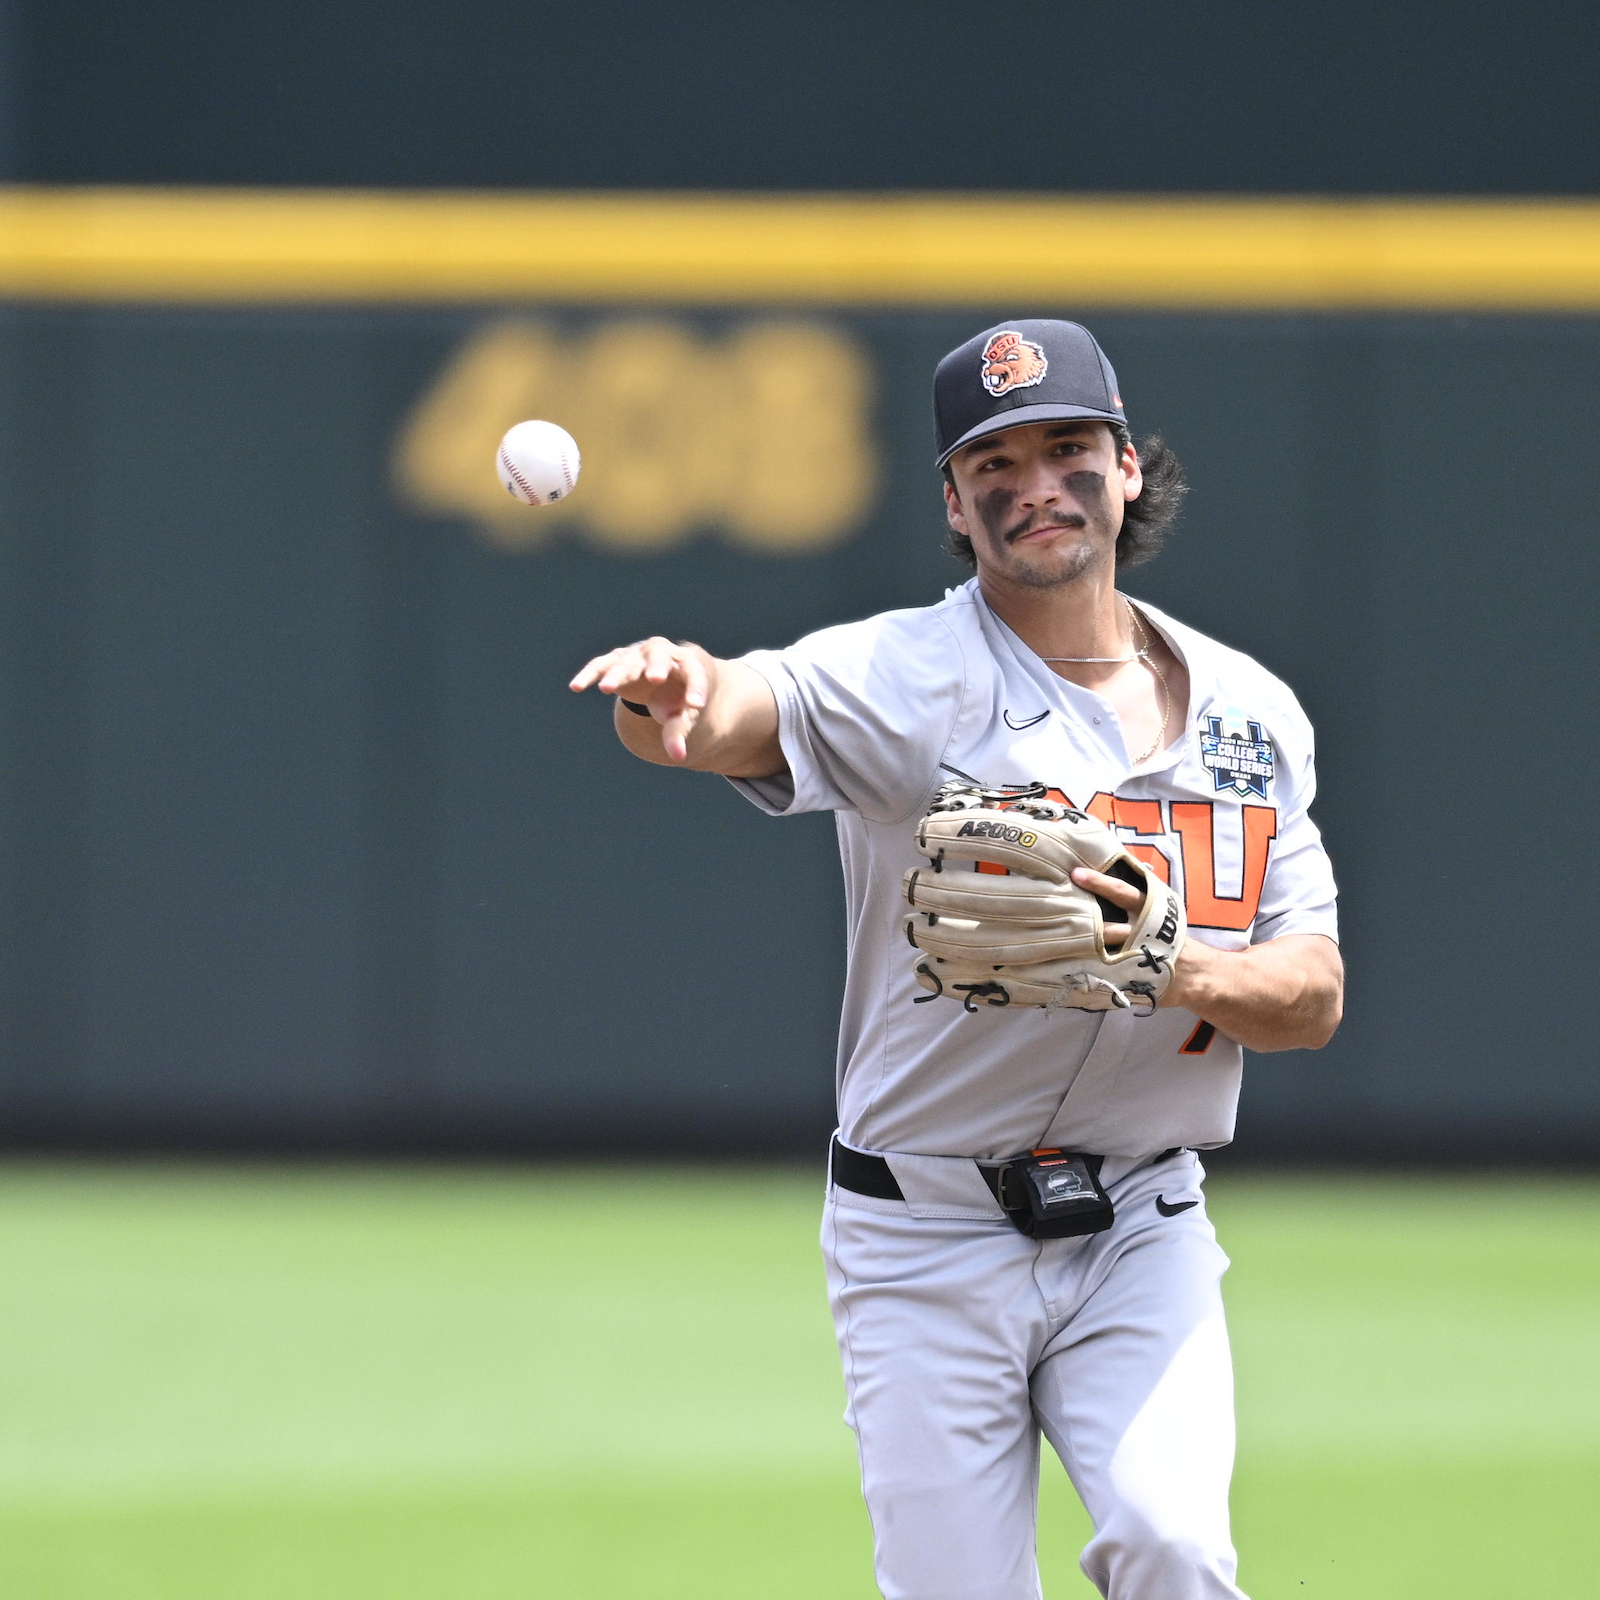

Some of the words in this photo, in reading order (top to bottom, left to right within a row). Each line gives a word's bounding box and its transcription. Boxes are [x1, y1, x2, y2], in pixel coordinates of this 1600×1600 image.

[989, 336, 1016, 360] OSU
[1217, 743, 1259, 761] COLLEGE
[1204, 754, 1239, 772] WORLD
[1240, 761, 1272, 778] SERIES
[1230, 771, 1252, 780] OMAHA
[957, 821, 1038, 848] A2000
